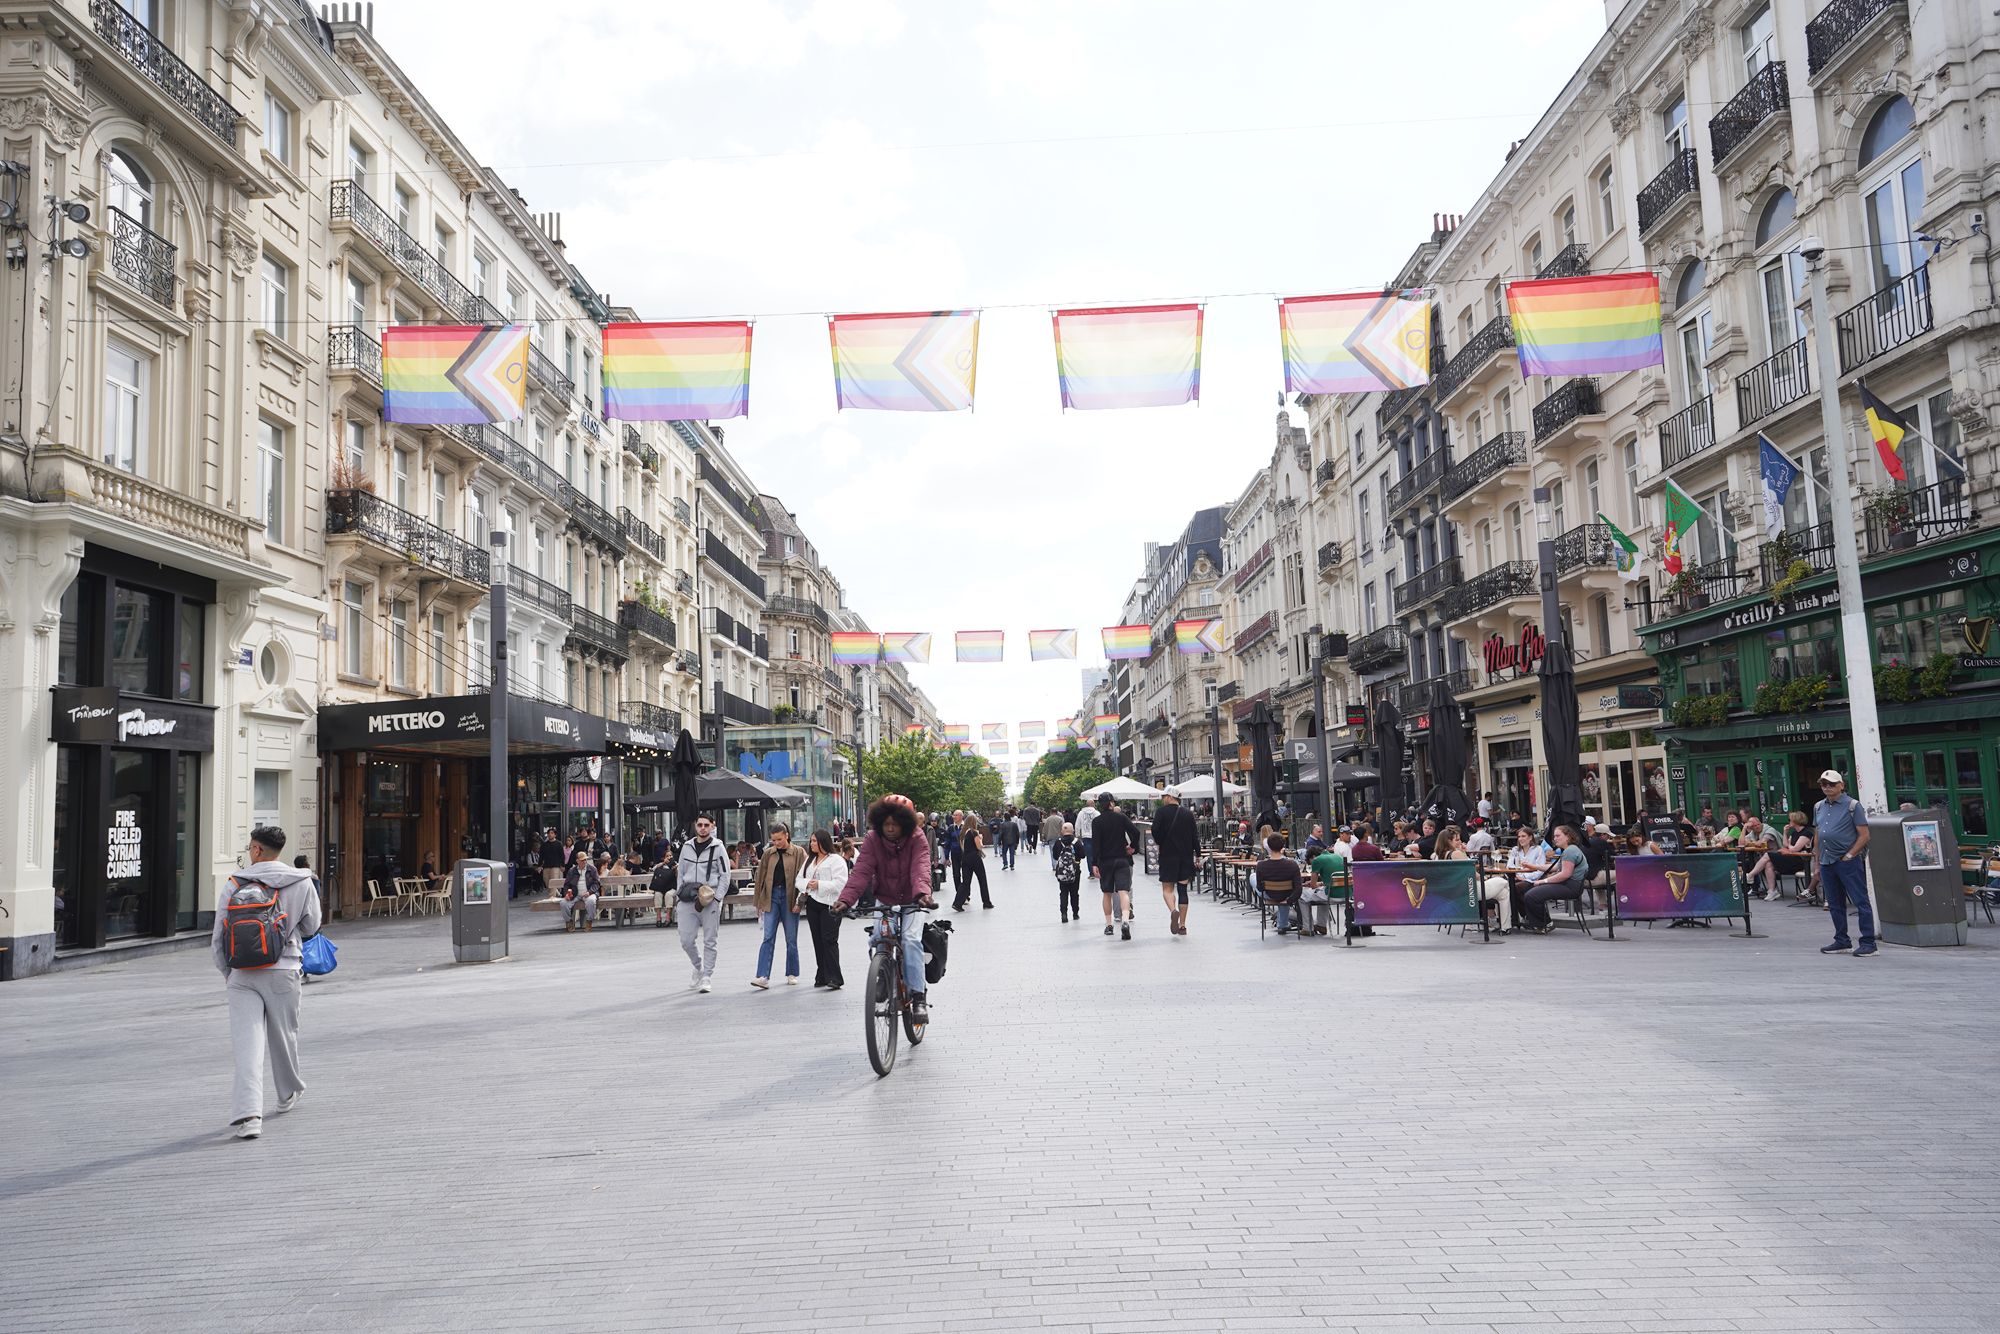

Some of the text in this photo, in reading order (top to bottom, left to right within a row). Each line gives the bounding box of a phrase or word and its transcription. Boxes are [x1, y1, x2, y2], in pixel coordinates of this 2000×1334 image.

[1795, 594, 1819, 611] irish
[1822, 589, 1840, 608] pub
[1483, 634, 1515, 673] Mon
[368, 710, 446, 733] METTEKO
[544, 716, 570, 736] METTEKO
[1776, 721, 1811, 732] irish pub
[1783, 731, 1834, 743] irish pub
[1294, 742, 1307, 760] P
[115, 810, 136, 828] FIRE
[108, 827, 142, 845] FUELED
[108, 843, 141, 862] SYRIAN
[106, 860, 142, 879] CUISINE
[1468, 877, 1476, 908] GUINNESS
[1730, 869, 1739, 900] GUINNESS
